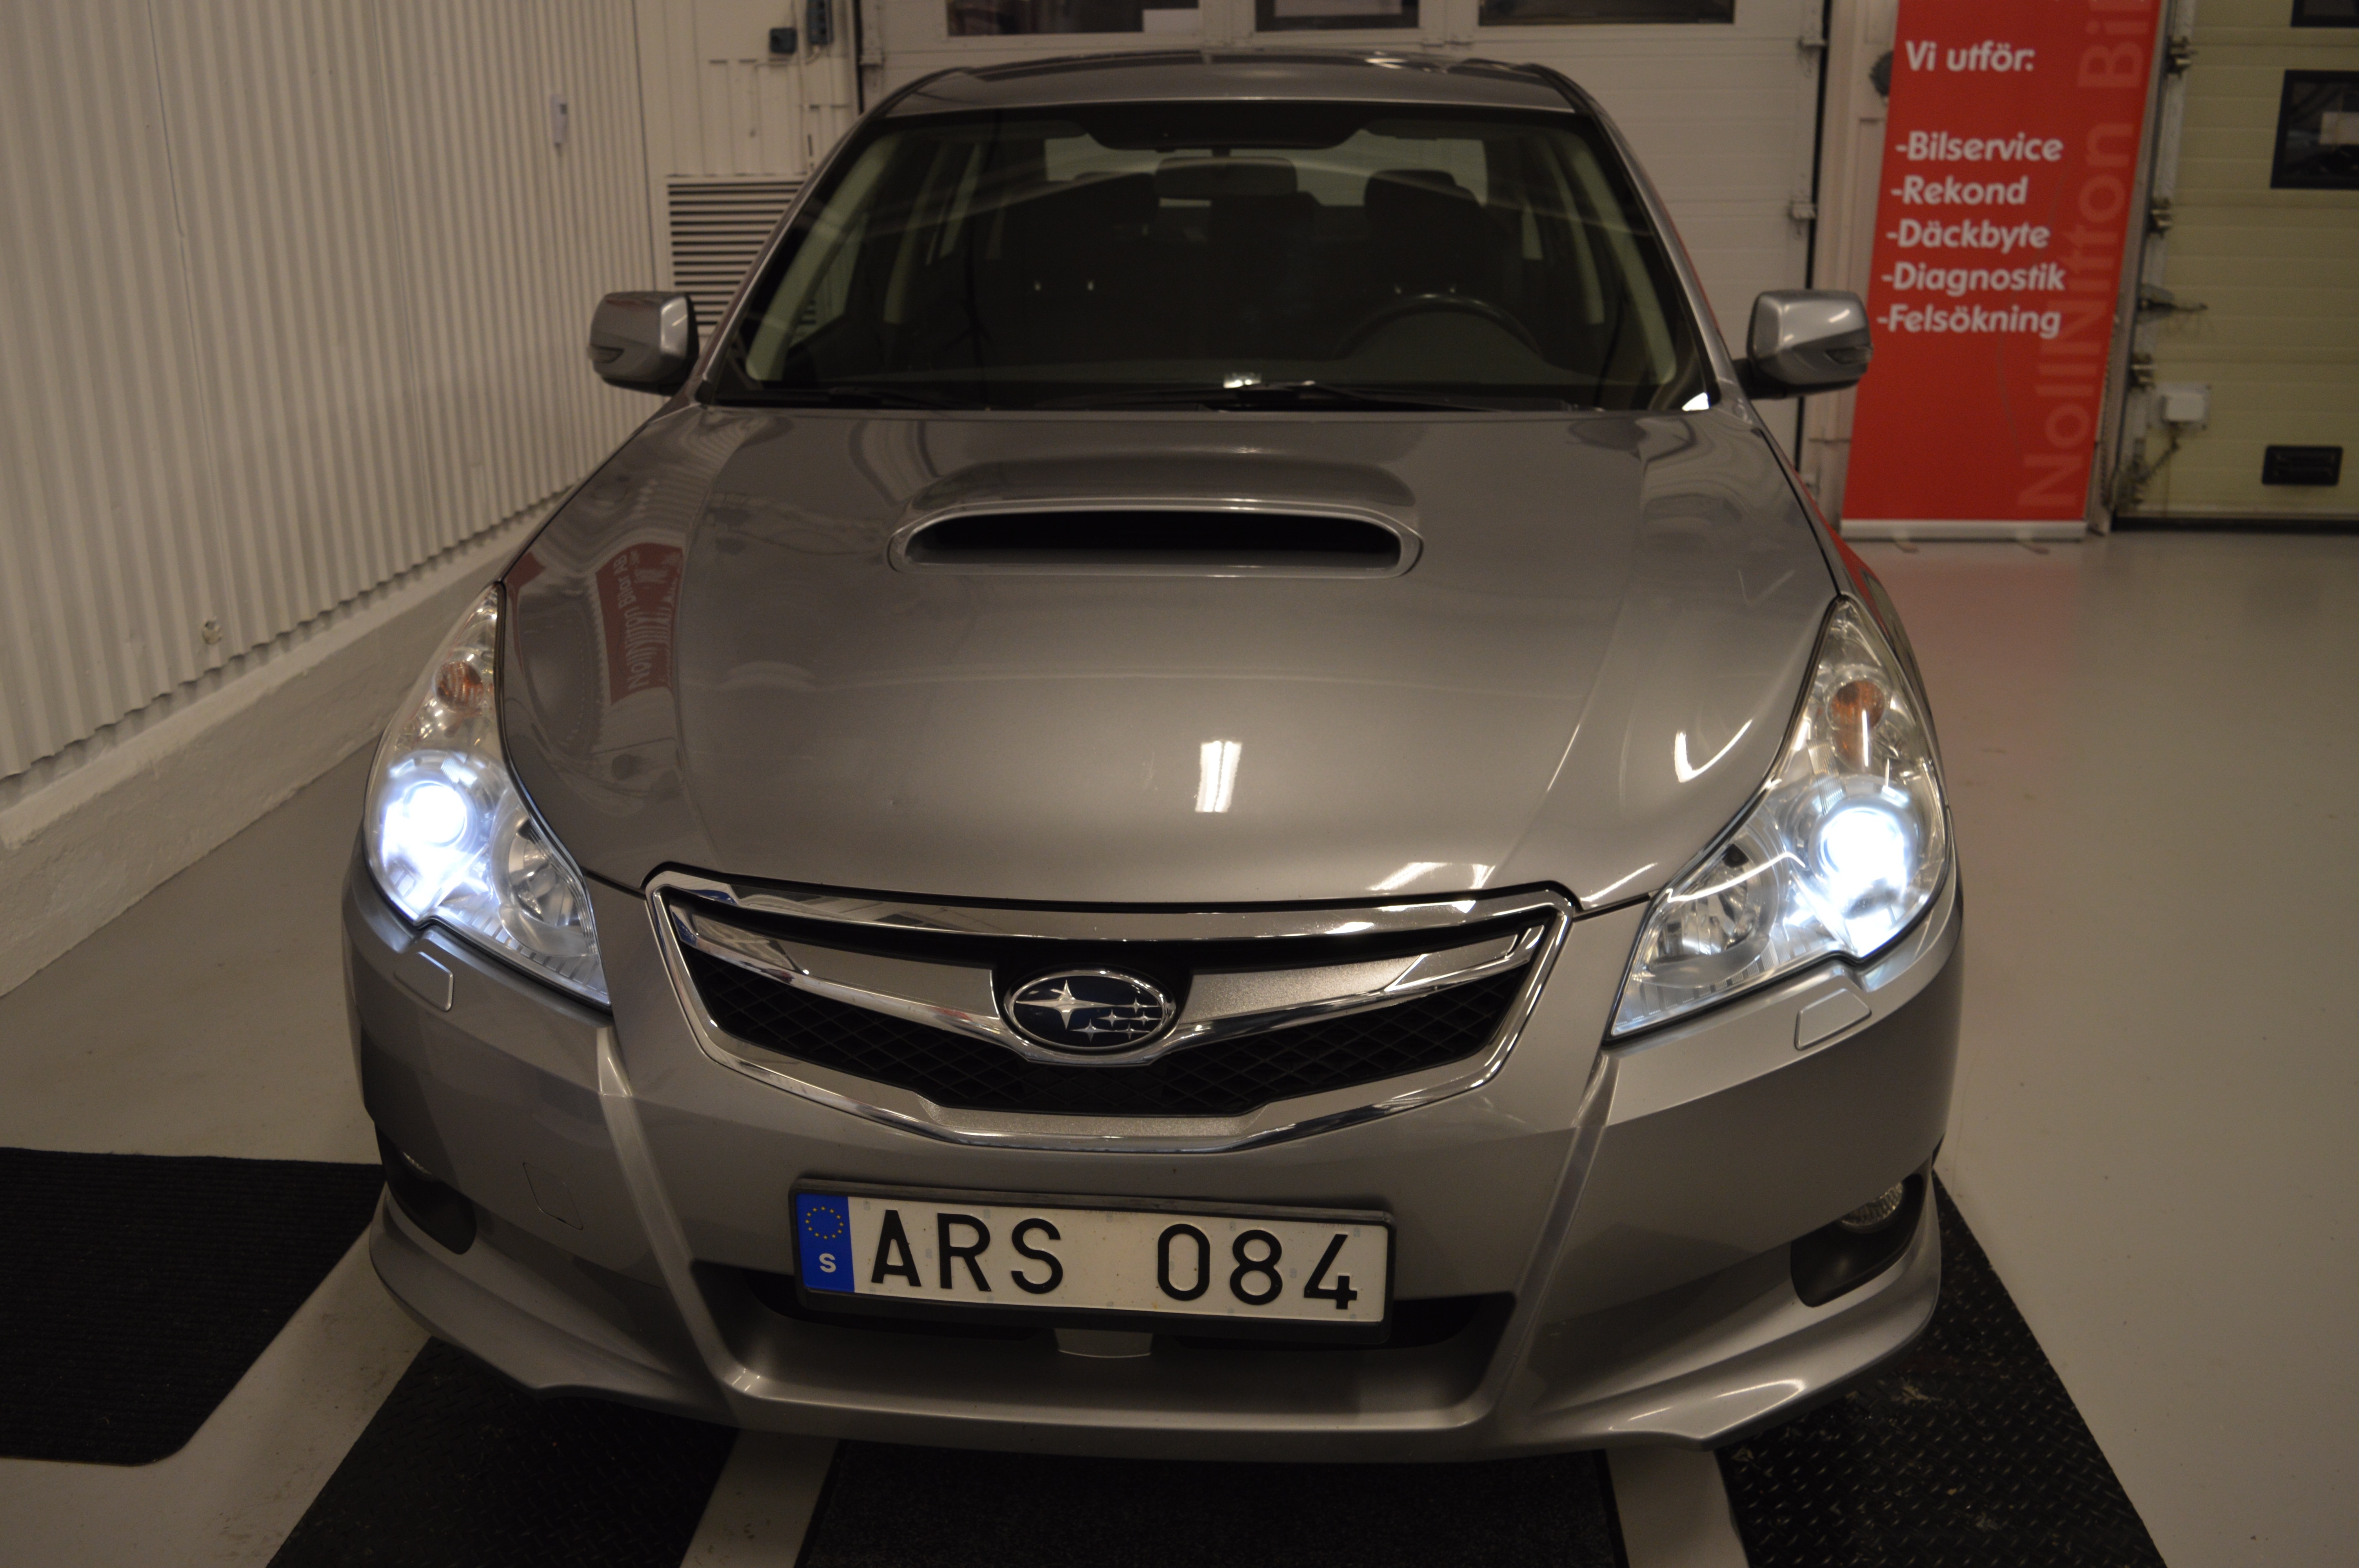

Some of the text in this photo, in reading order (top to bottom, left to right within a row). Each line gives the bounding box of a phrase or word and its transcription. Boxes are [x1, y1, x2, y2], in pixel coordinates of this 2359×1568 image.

[1905, 40, 2035, 71] Vi utför:
[1896, 131, 2063, 161] -Bilservice
[1891, 175, 2028, 205] -Rekond
[1886, 218, 2050, 254] -Däckbyte
[1881, 261, 2065, 297] -Diagnostik
[1877, 303, 2061, 339] -Felsökning
[2016, 122, 2135, 506] NollNitton
[613, 554, 628, 575] AB
[819, 1253, 836, 1273] S
[871, 1209, 1358, 1310] ARS 084
